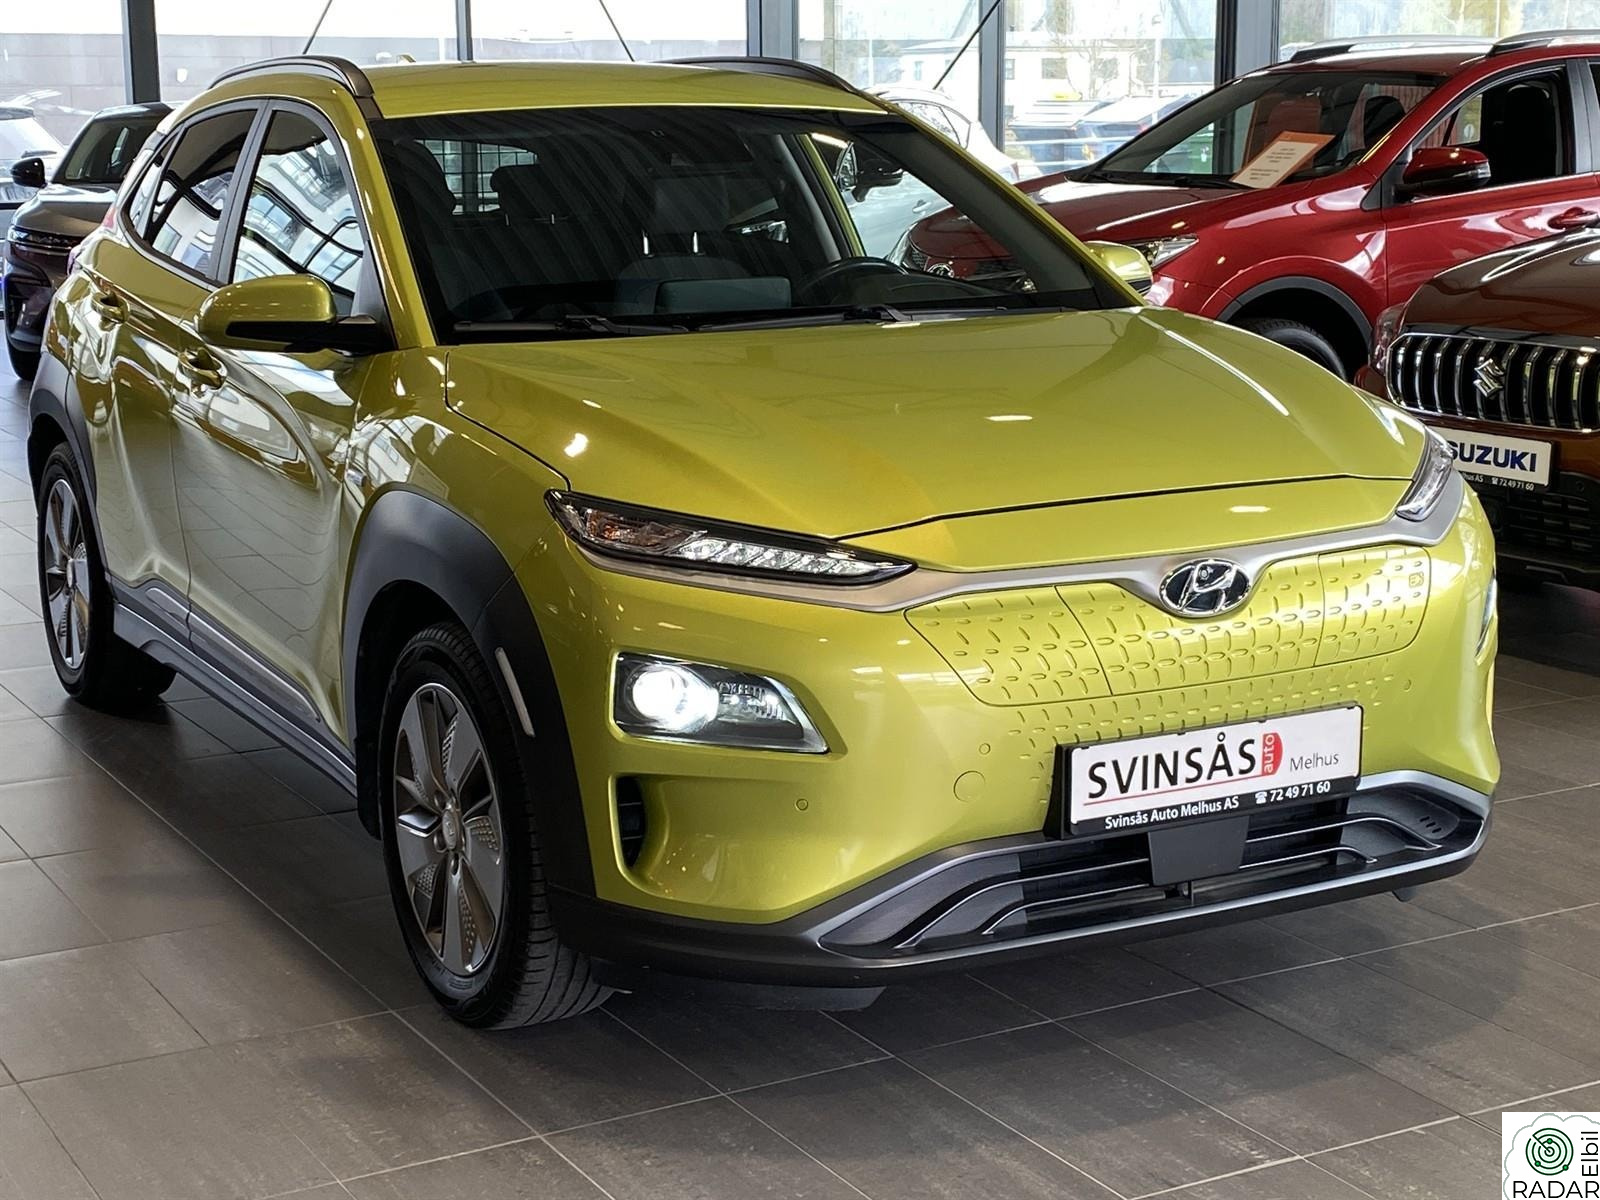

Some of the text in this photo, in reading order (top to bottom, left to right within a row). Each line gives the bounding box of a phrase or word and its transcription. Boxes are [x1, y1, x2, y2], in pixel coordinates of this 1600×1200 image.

[1448, 440, 1537, 473] SUZUKI
[1500, 478, 1507, 487] 72
[1088, 732, 1256, 799] SVINSÅS
[1264, 734, 1275, 774] auto
[1290, 753, 1339, 772] Melhus
[1105, 781, 1331, 829] Svinsås Auto Melhus AS 72 49 71 60
